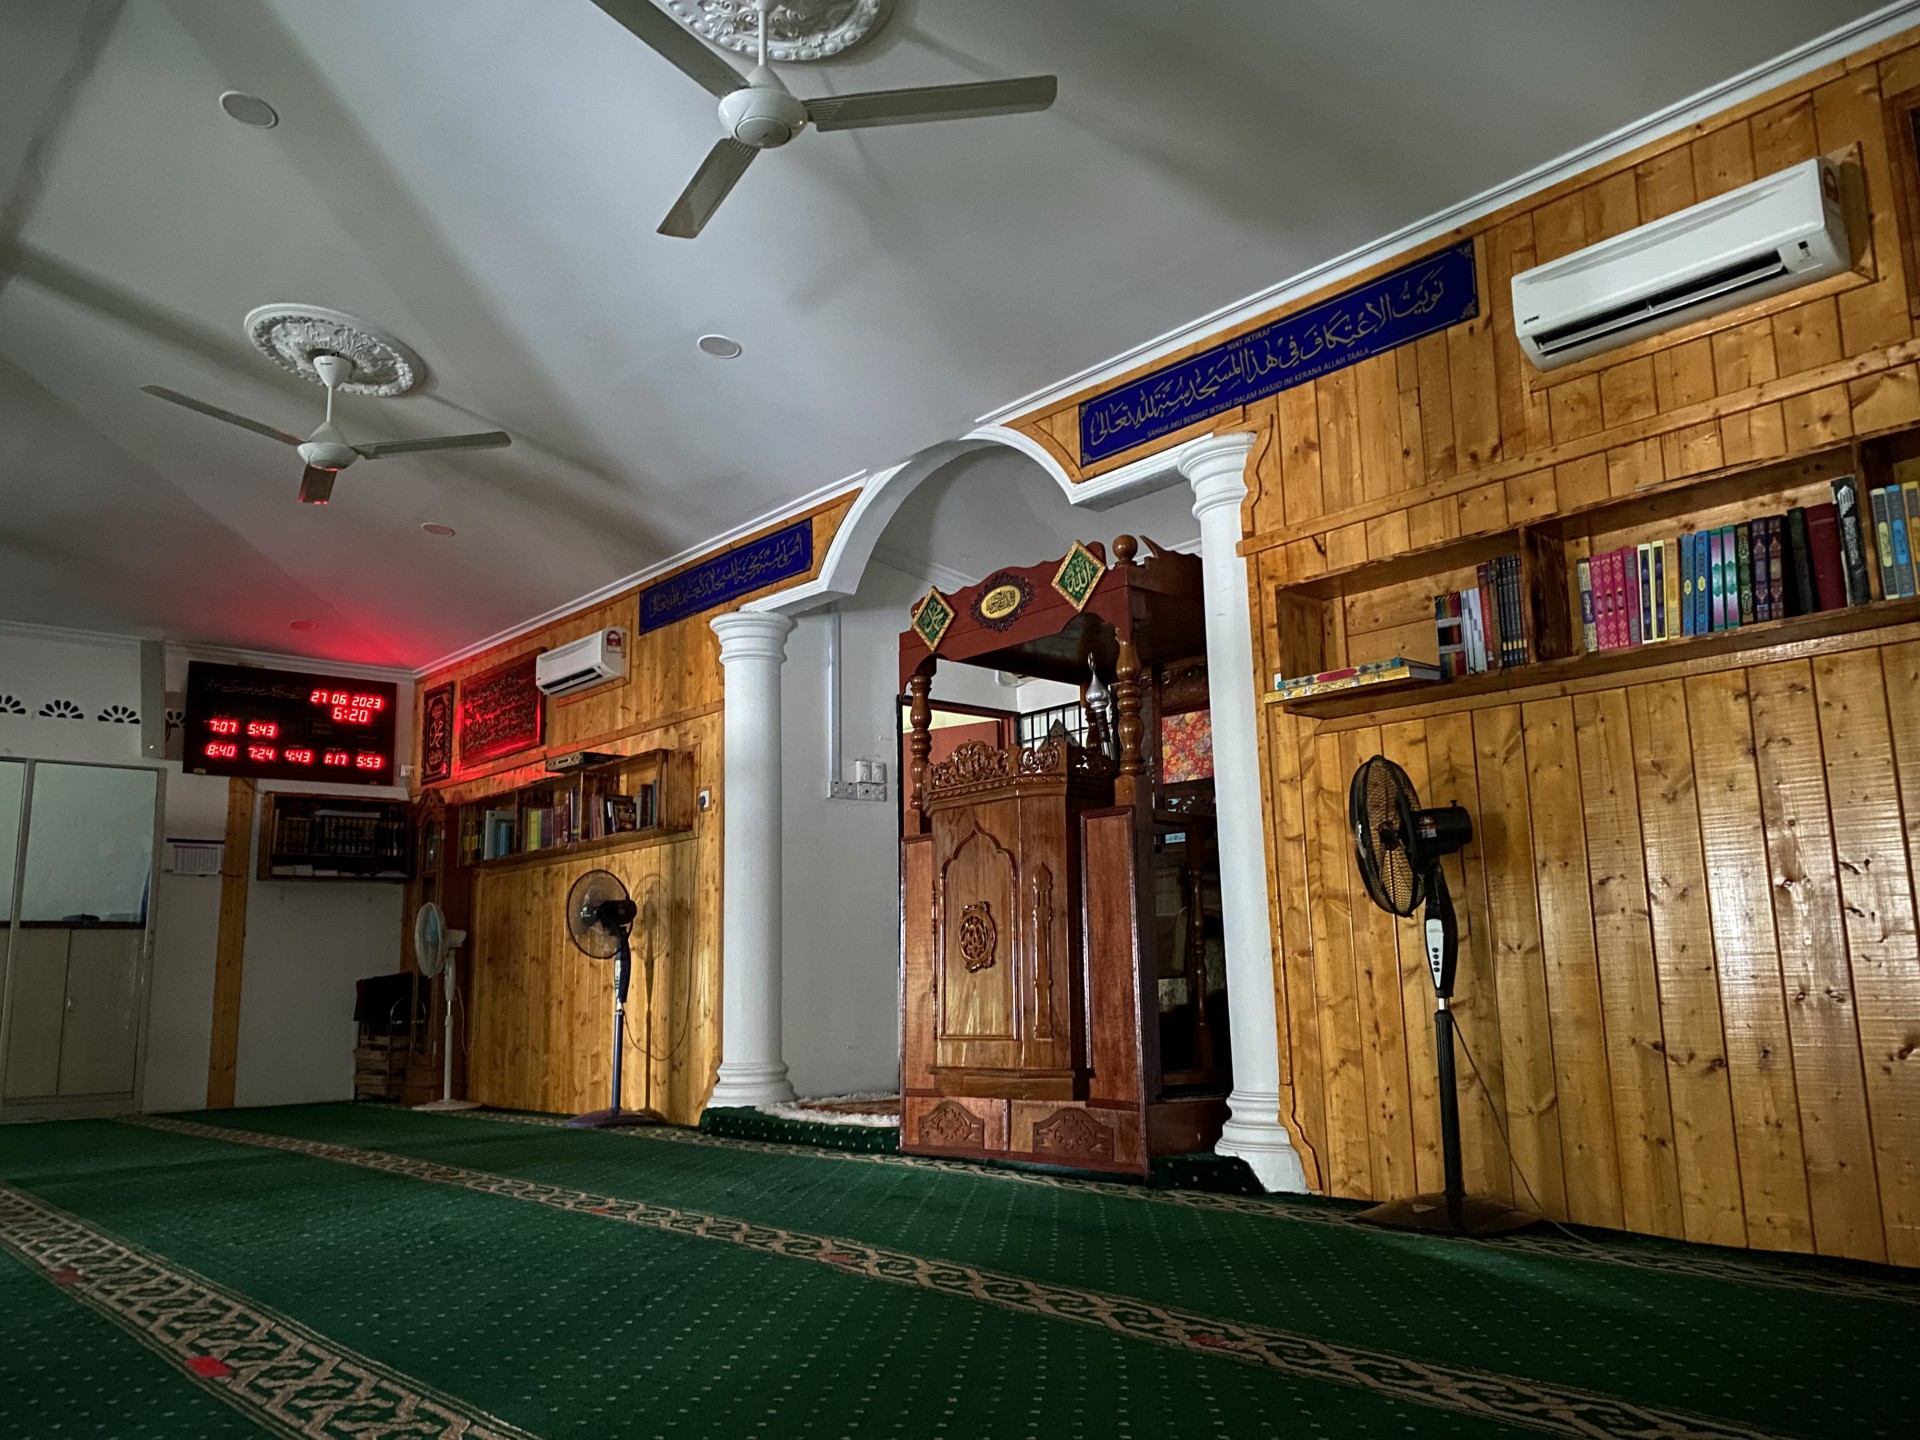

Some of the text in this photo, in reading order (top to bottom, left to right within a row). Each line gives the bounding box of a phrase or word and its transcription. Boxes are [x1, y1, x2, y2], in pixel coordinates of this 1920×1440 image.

[1226, 327, 1272, 351] NIAT IKTIKAF
[1147, 347, 1370, 438] SAHAJA AKU BERNIAT IKTIKAF DALAM MASJID INI KERANA ALLAH TAALA
[310, 691, 381, 709] 27 06 2023
[332, 706, 369, 722] 6:20
[209, 720, 275, 737] 7:07 5:43
[207, 744, 236, 757] 8:40
[247, 747, 274, 760] 7:24
[285, 749, 311, 763] 4:43
[355, 755, 381, 768] 5:53
